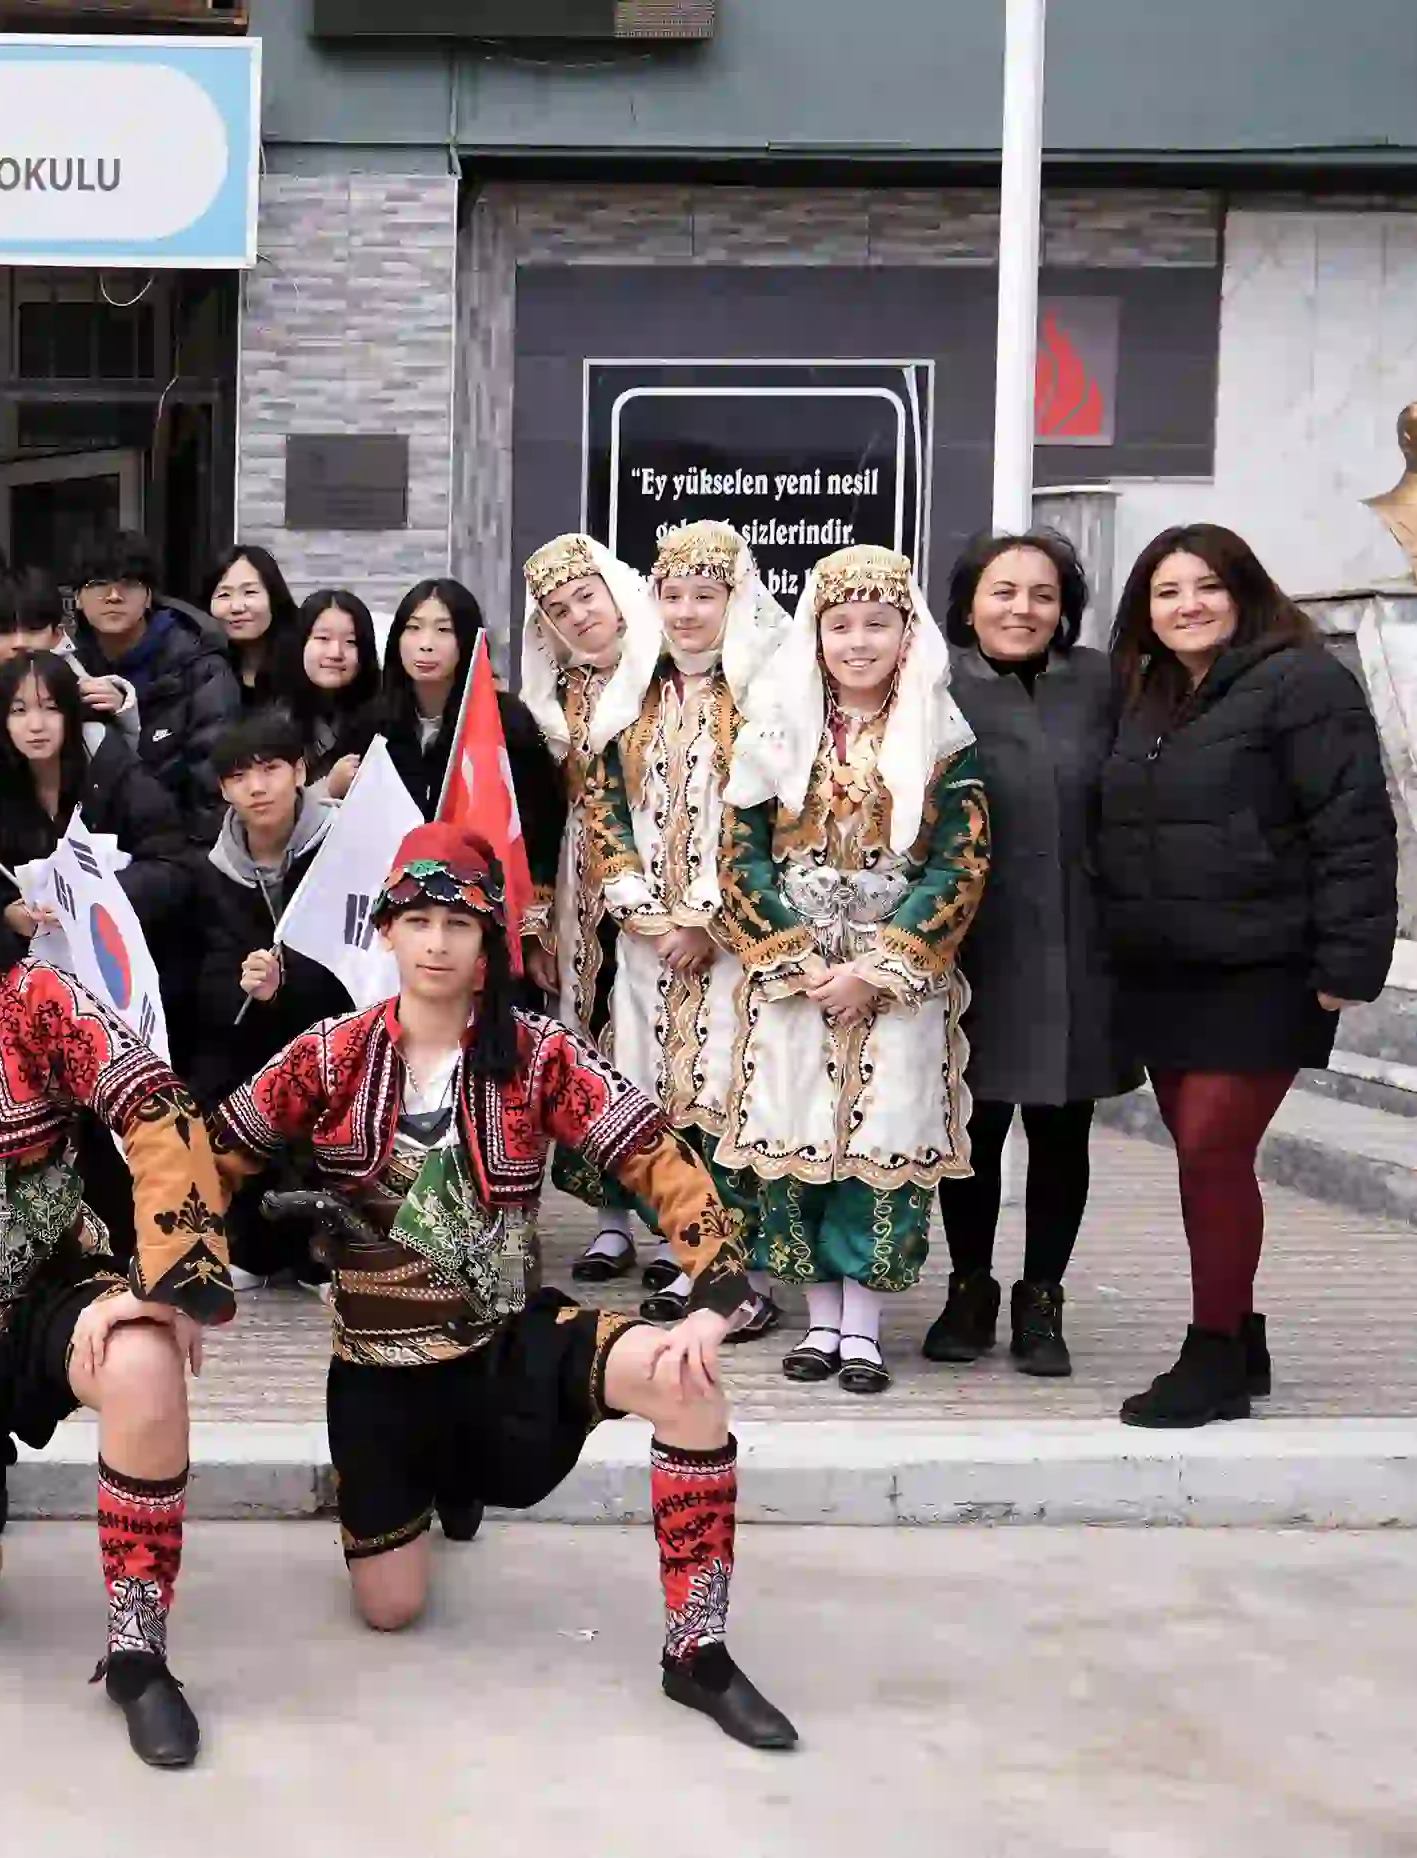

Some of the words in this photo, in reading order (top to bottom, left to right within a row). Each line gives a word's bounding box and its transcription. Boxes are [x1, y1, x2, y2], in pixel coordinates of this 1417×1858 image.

[673, 466, 768, 500] yükselen
[774, 468, 821, 500] yeni
[827, 468, 879, 495] nesil
[741, 518, 855, 545] sizlerindir.
[768, 568, 798, 595] biz
